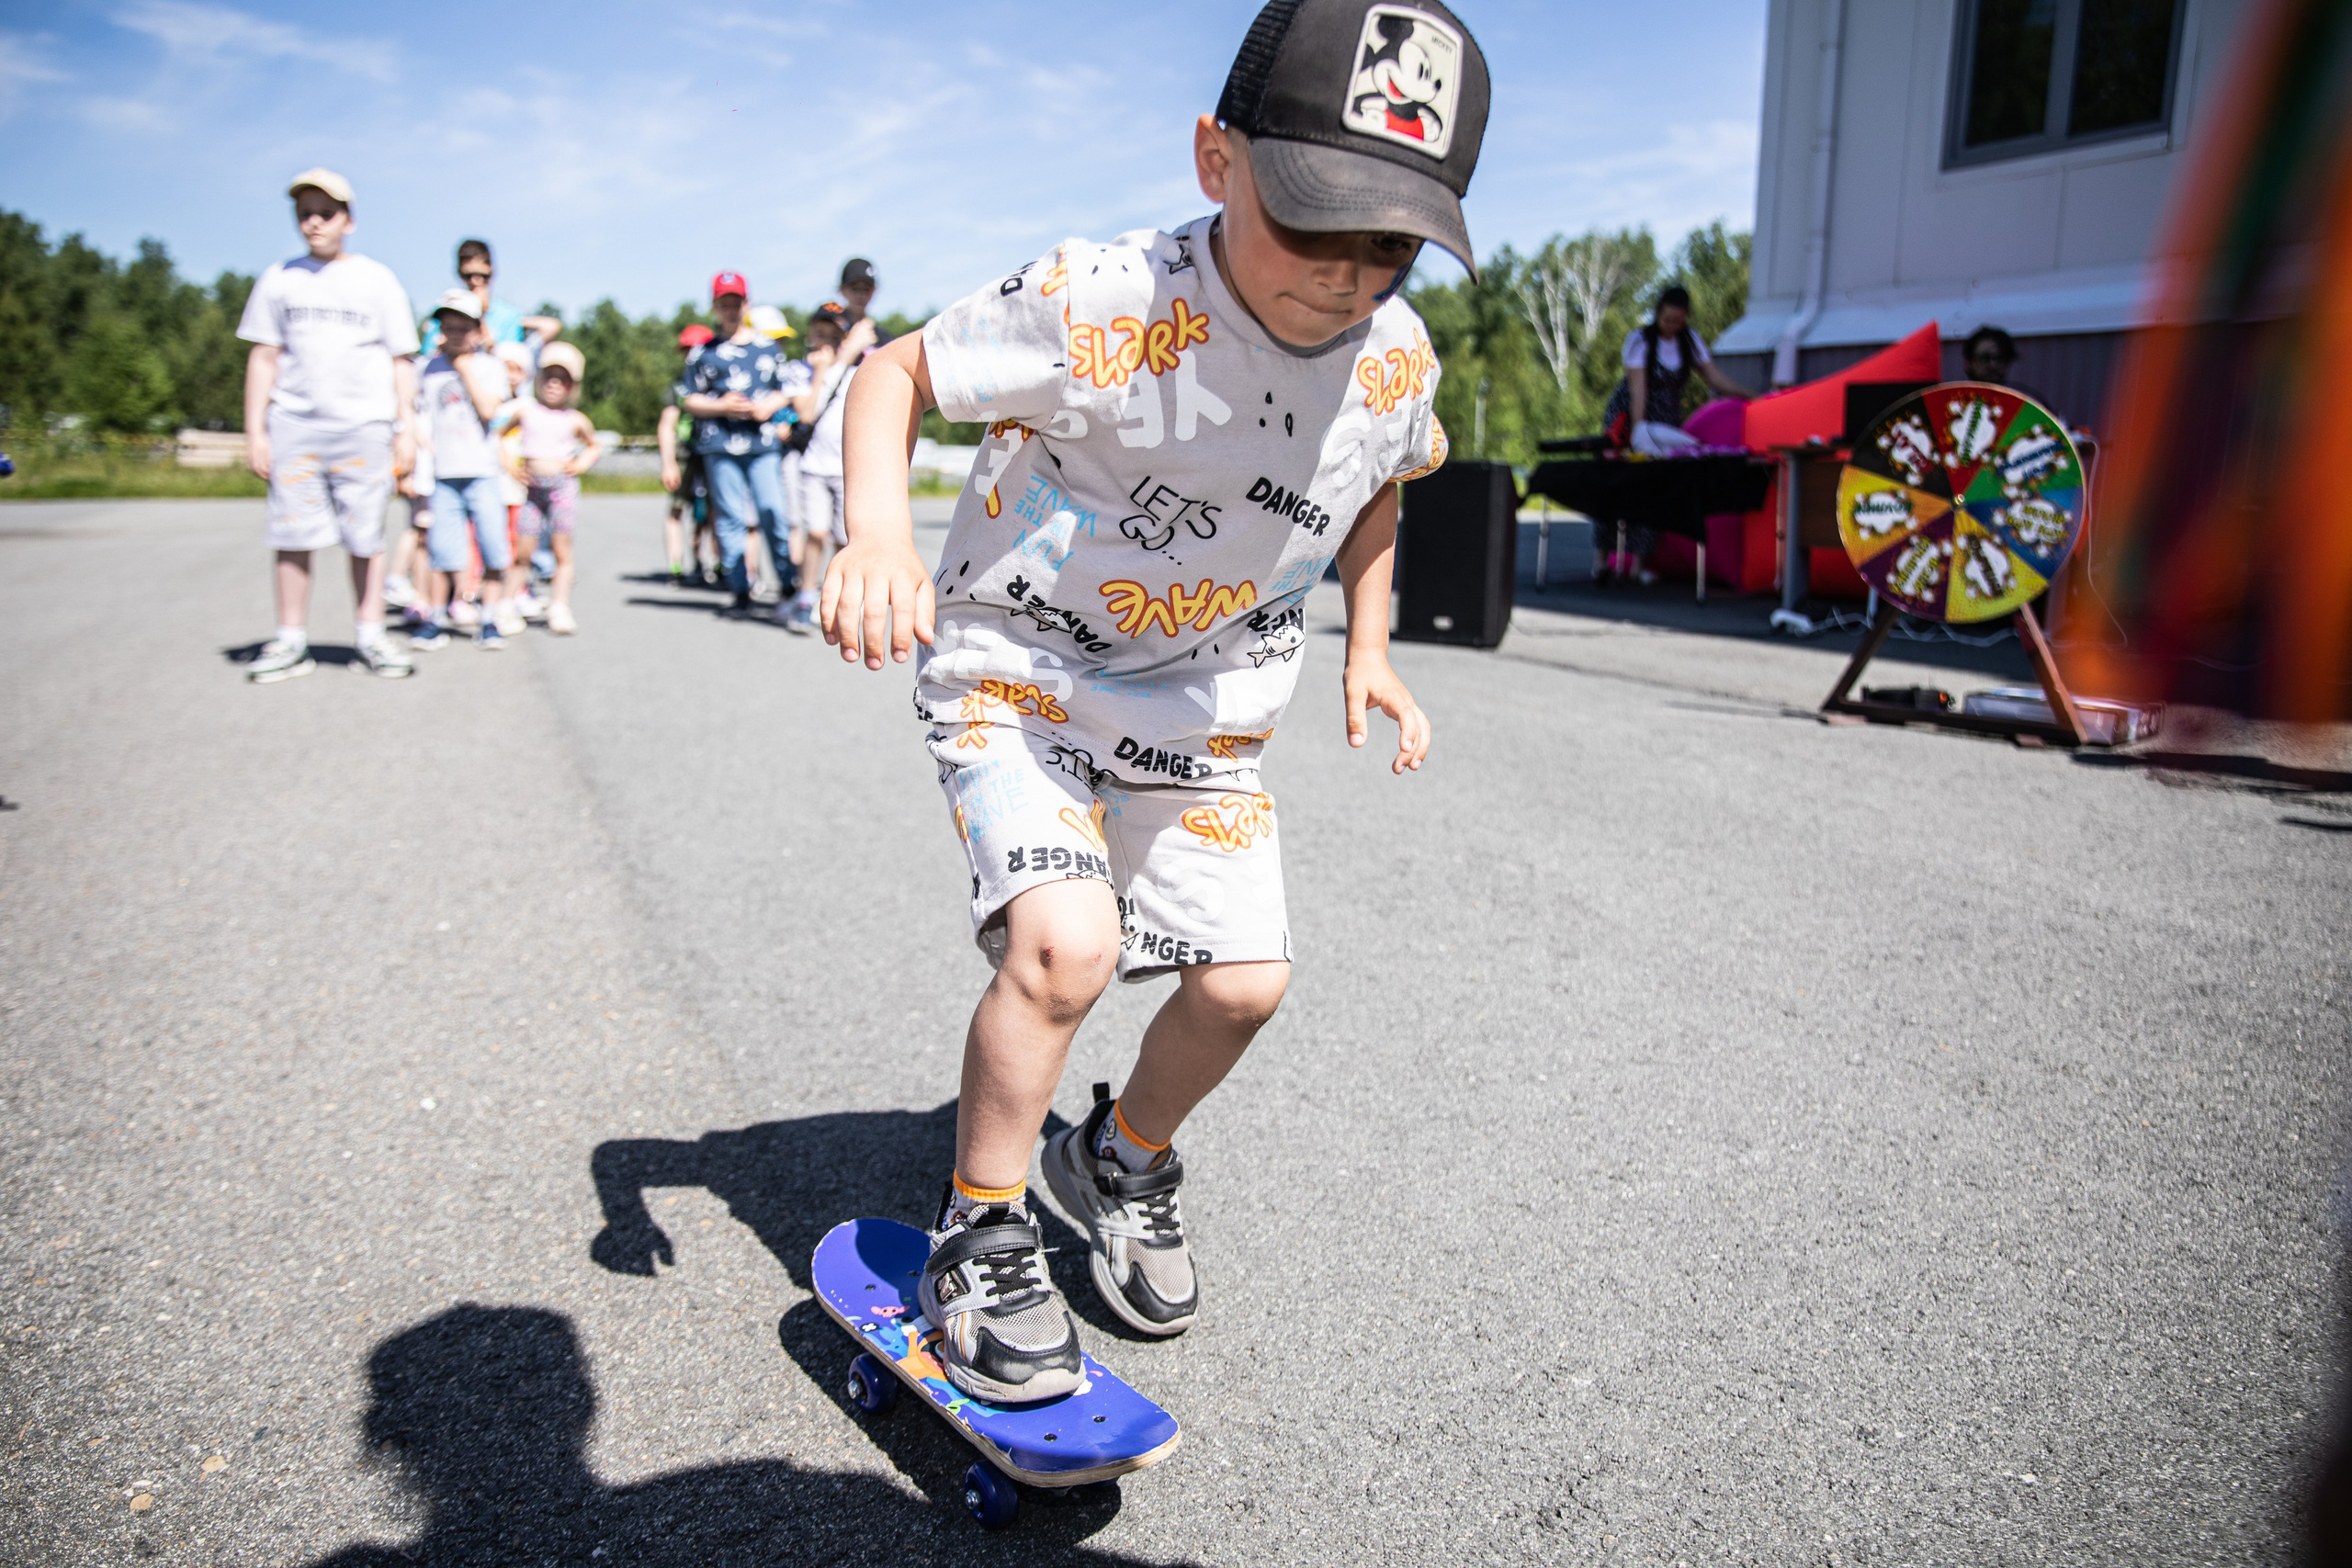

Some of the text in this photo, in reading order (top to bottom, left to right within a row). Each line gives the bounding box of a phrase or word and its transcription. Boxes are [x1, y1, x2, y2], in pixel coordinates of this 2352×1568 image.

[1014, 499, 1043, 528] THE
[1031, 475, 1097, 538] WAVE
[1129, 476, 1222, 539] LET'S
[1245, 477, 1330, 536] DANGER
[1012, 528, 1074, 572] FUN
[1007, 574, 1113, 653] DANER
[1098, 578, 1258, 639] WAVE
[1114, 736, 1213, 779] DANGER
[1008, 846, 1111, 878] ANGER
